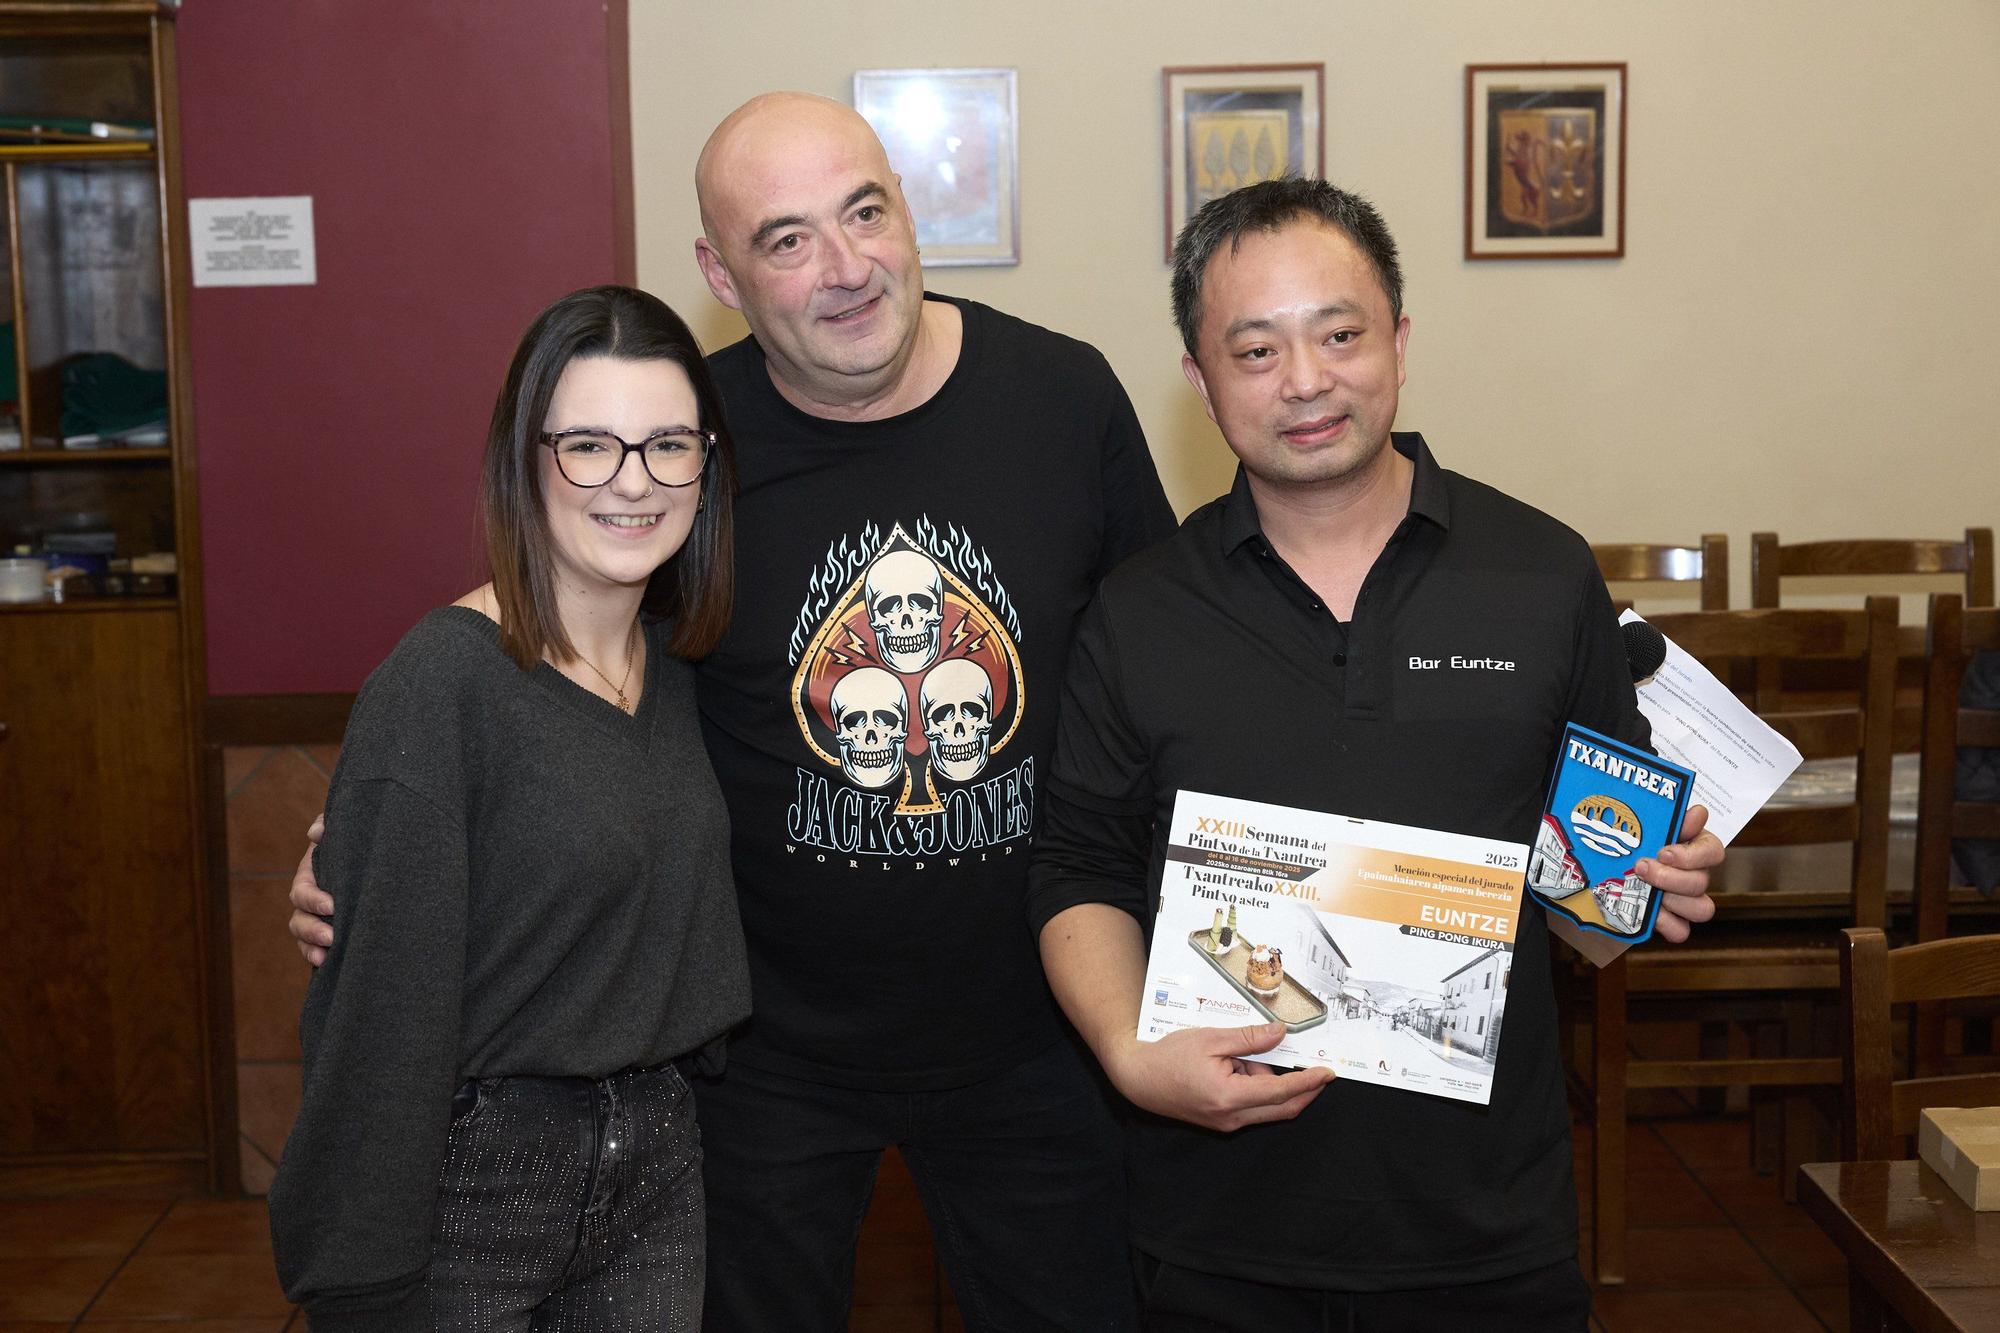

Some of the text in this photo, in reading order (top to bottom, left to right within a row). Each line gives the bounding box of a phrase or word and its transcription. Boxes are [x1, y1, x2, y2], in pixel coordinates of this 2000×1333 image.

[1409, 656, 1515, 671] Bar Euntze
[1569, 739, 1678, 800] TXANTREA
[1188, 833, 1327, 868] Pintxo de la Txantrea
[1312, 841, 1326, 851] del
[1206, 859, 1229, 869] 2025ko
[1230, 864, 1260, 874] azaroaren
[1250, 858, 1283, 869] noviembre
[1284, 863, 1301, 873] 2025
[1485, 853, 1518, 868] 2025
[1184, 865, 1321, 902] Txantreako XXIII.
[1394, 864, 1514, 891] Mención especial del jurado
[1192, 884, 1269, 909] Pintxo astea
[1433, 881, 1474, 896] aipamen
[1476, 887, 1512, 902] berezia
[1420, 905, 1510, 935] EUNTZE
[1409, 926, 1505, 950] PING PONG IKURA
